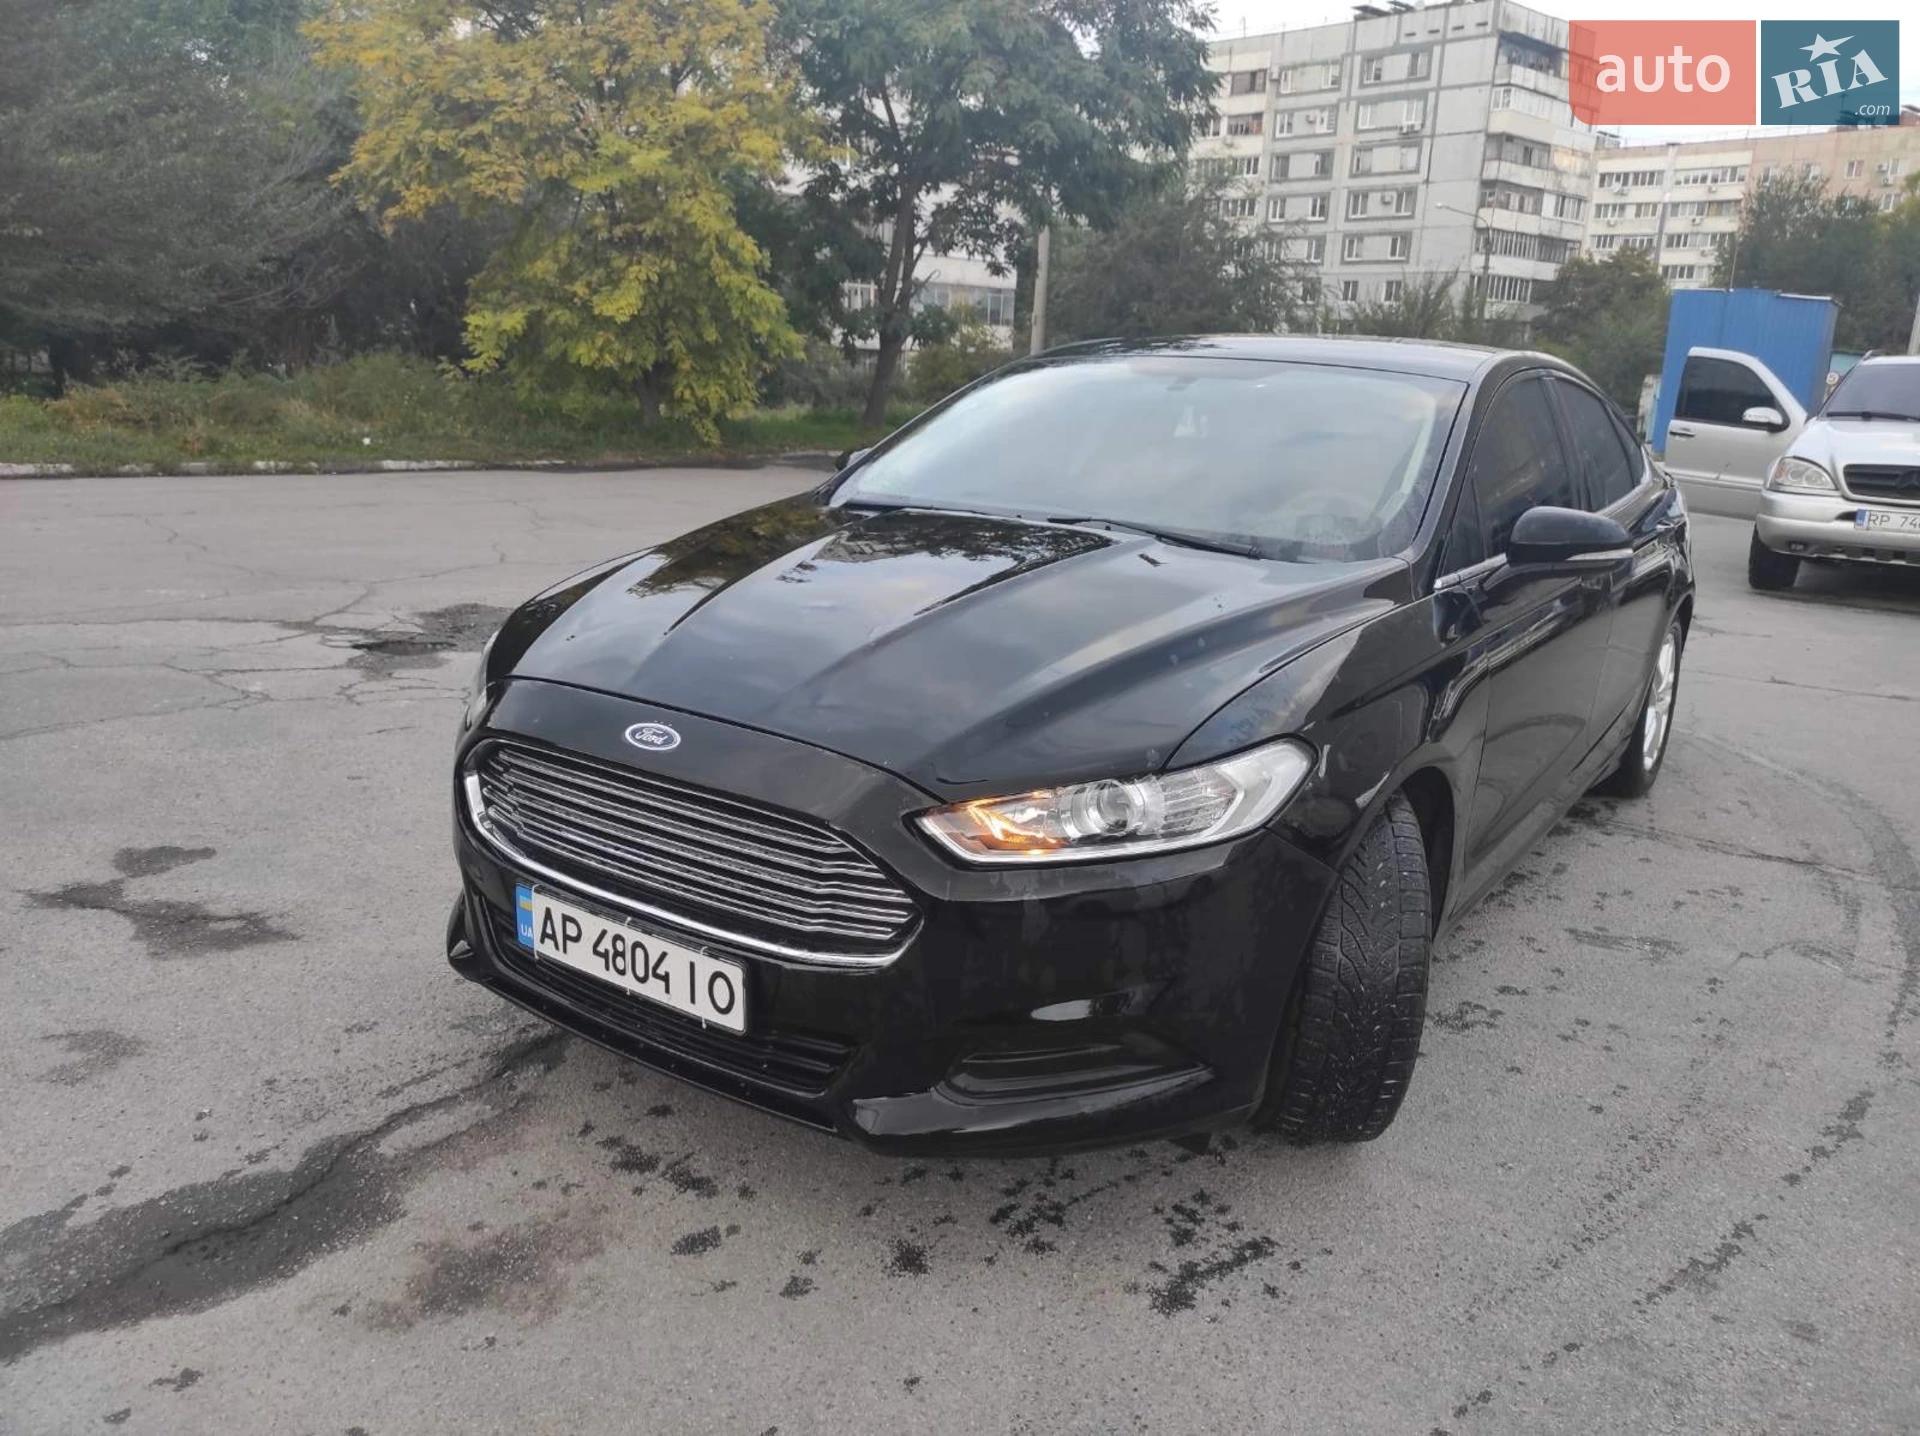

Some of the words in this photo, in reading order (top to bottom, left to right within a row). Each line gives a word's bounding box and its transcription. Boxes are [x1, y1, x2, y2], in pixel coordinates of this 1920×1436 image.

[1869, 514, 1891, 527] RP
[1900, 515, 1920, 529] 74
[635, 727, 668, 745] Ford
[521, 923, 534, 940] UA
[539, 906, 583, 955] AP
[592, 928, 671, 995] 4804
